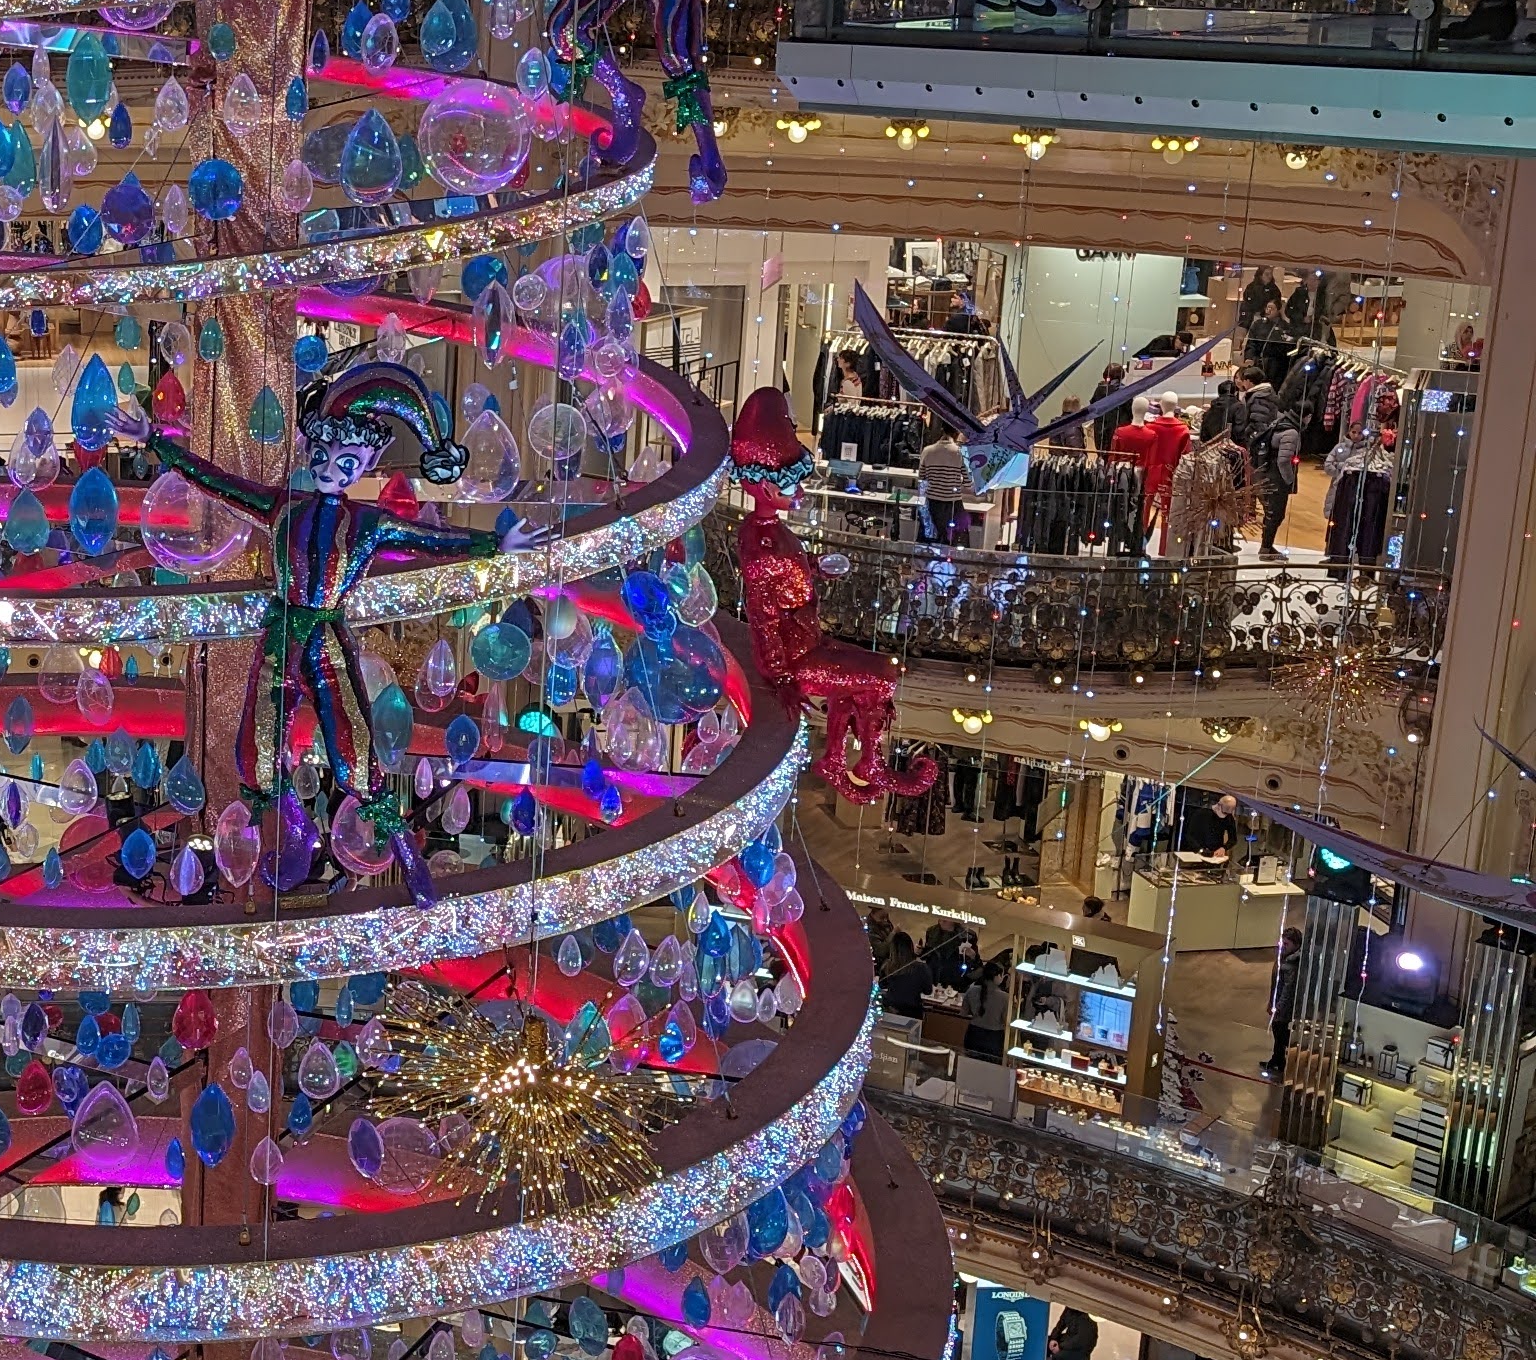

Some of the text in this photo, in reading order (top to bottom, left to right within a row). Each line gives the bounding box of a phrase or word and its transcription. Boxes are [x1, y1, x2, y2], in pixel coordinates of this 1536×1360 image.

[845, 889, 987, 926] Maison Francis Kurkdjian
[991, 1291, 1031, 1299] LONGINE
